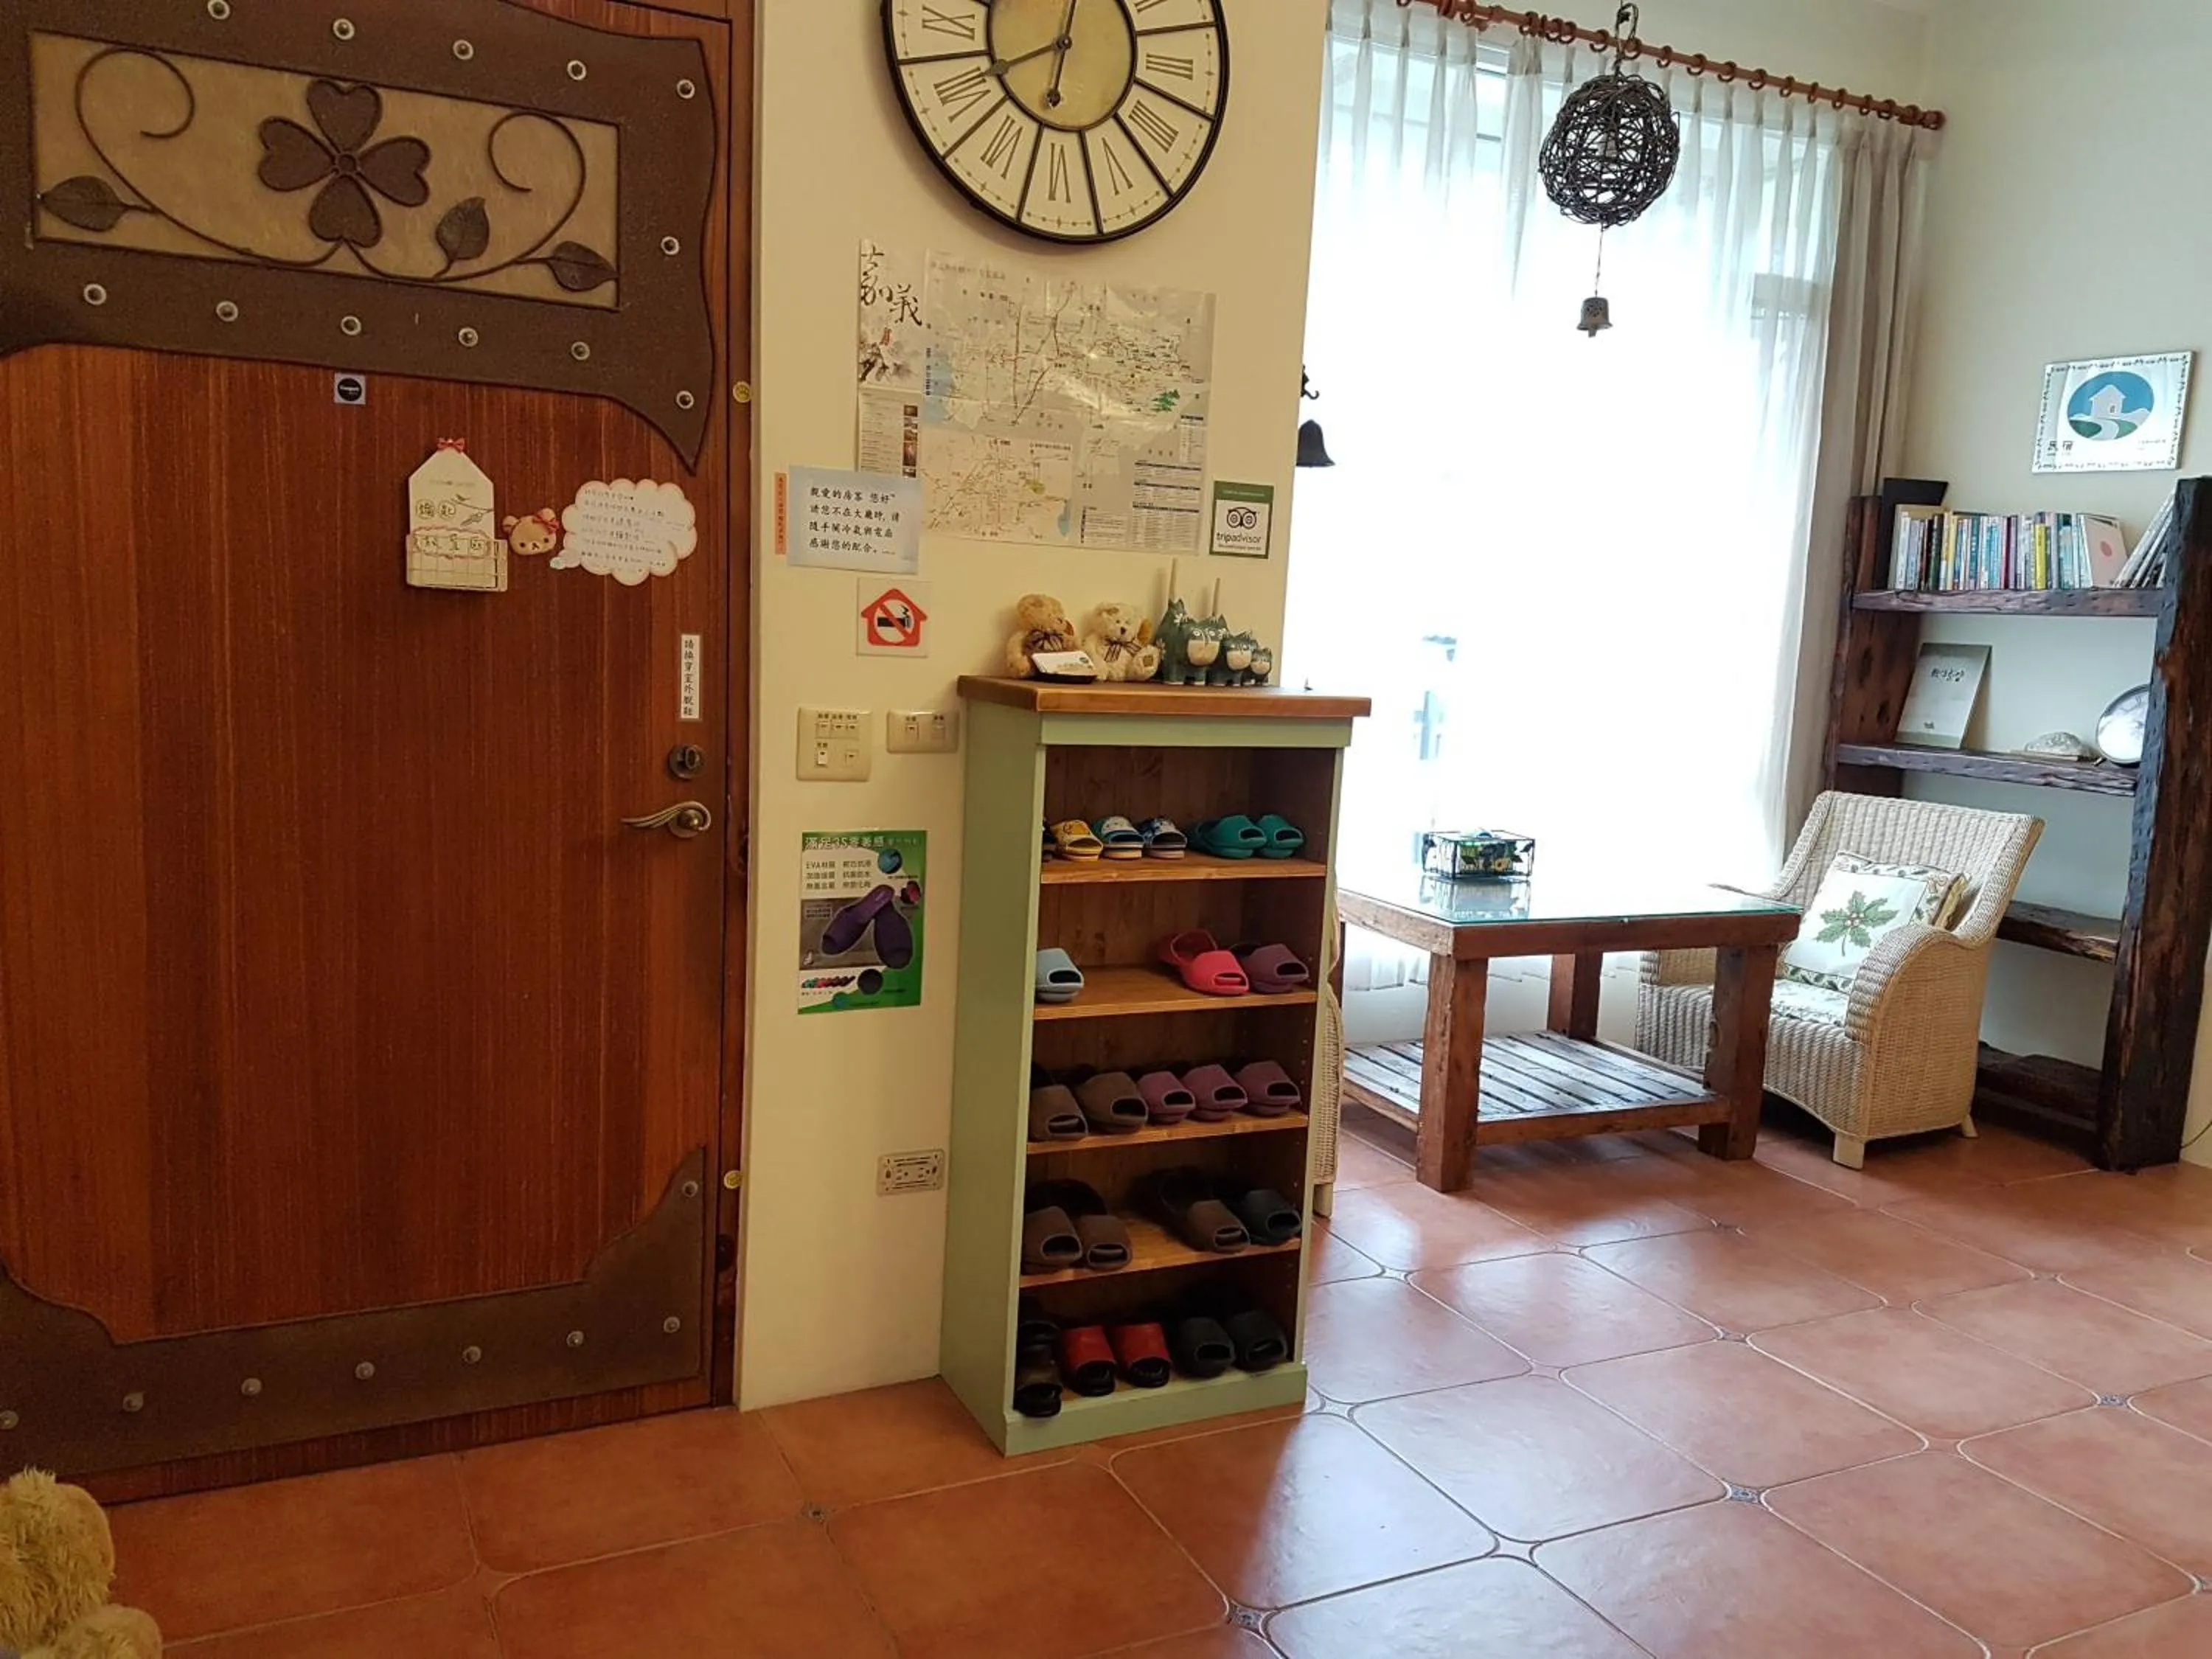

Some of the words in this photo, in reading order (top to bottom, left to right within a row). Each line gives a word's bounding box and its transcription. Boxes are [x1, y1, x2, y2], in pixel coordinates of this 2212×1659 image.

[1144, 52, 1194, 80] III
[980, 114, 1024, 179] VII
[1127, 99, 1180, 153] IIII
[1048, 142, 1072, 204] VI
[1102, 136, 1133, 196] V
[1216, 531, 1262, 543] tripadvisor
